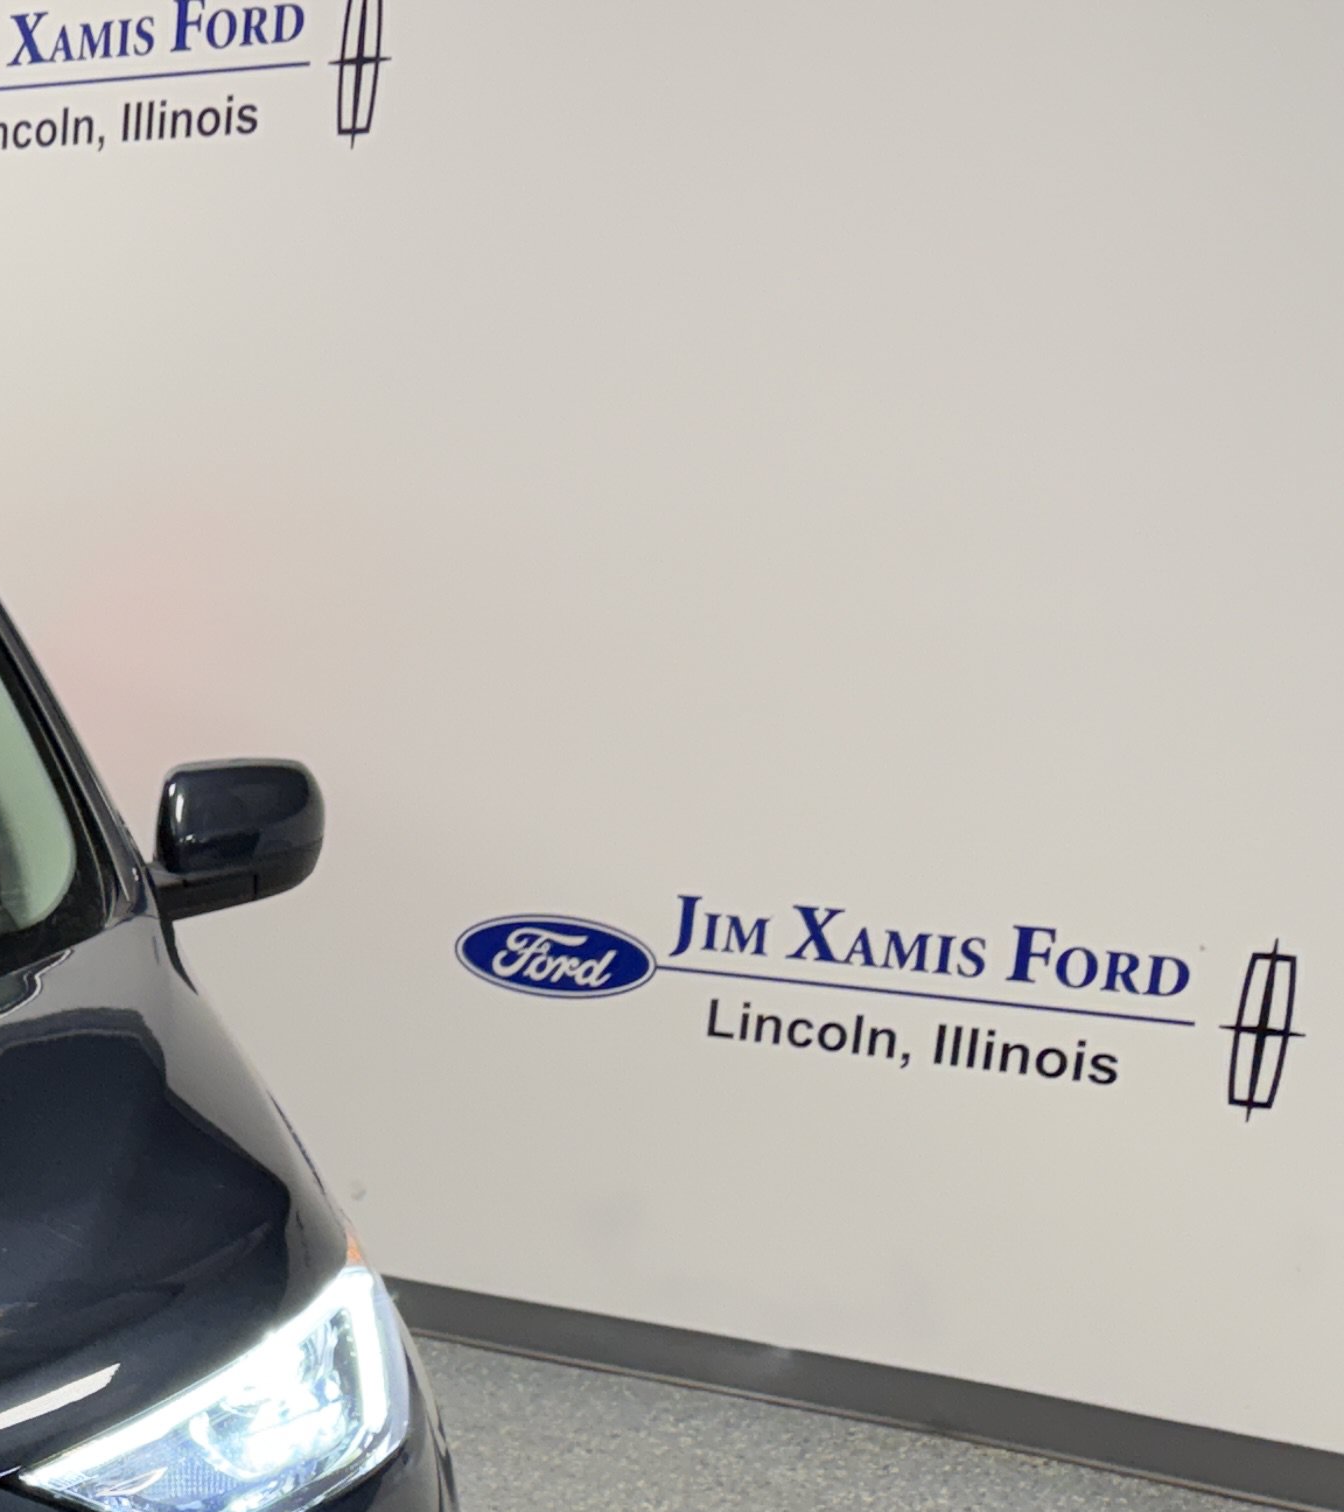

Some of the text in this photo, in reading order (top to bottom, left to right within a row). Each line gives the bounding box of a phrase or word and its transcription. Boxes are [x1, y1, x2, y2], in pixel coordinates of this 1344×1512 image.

[7, 13, 155, 68] XAMIS
[171, 0, 305, 52] FORD
[121, 95, 258, 142] Illinois
[492, 927, 616, 988] Ford
[668, 895, 1191, 998] JIM XAMIS FORD
[707, 999, 1118, 1086] Lincoln, Illinois
